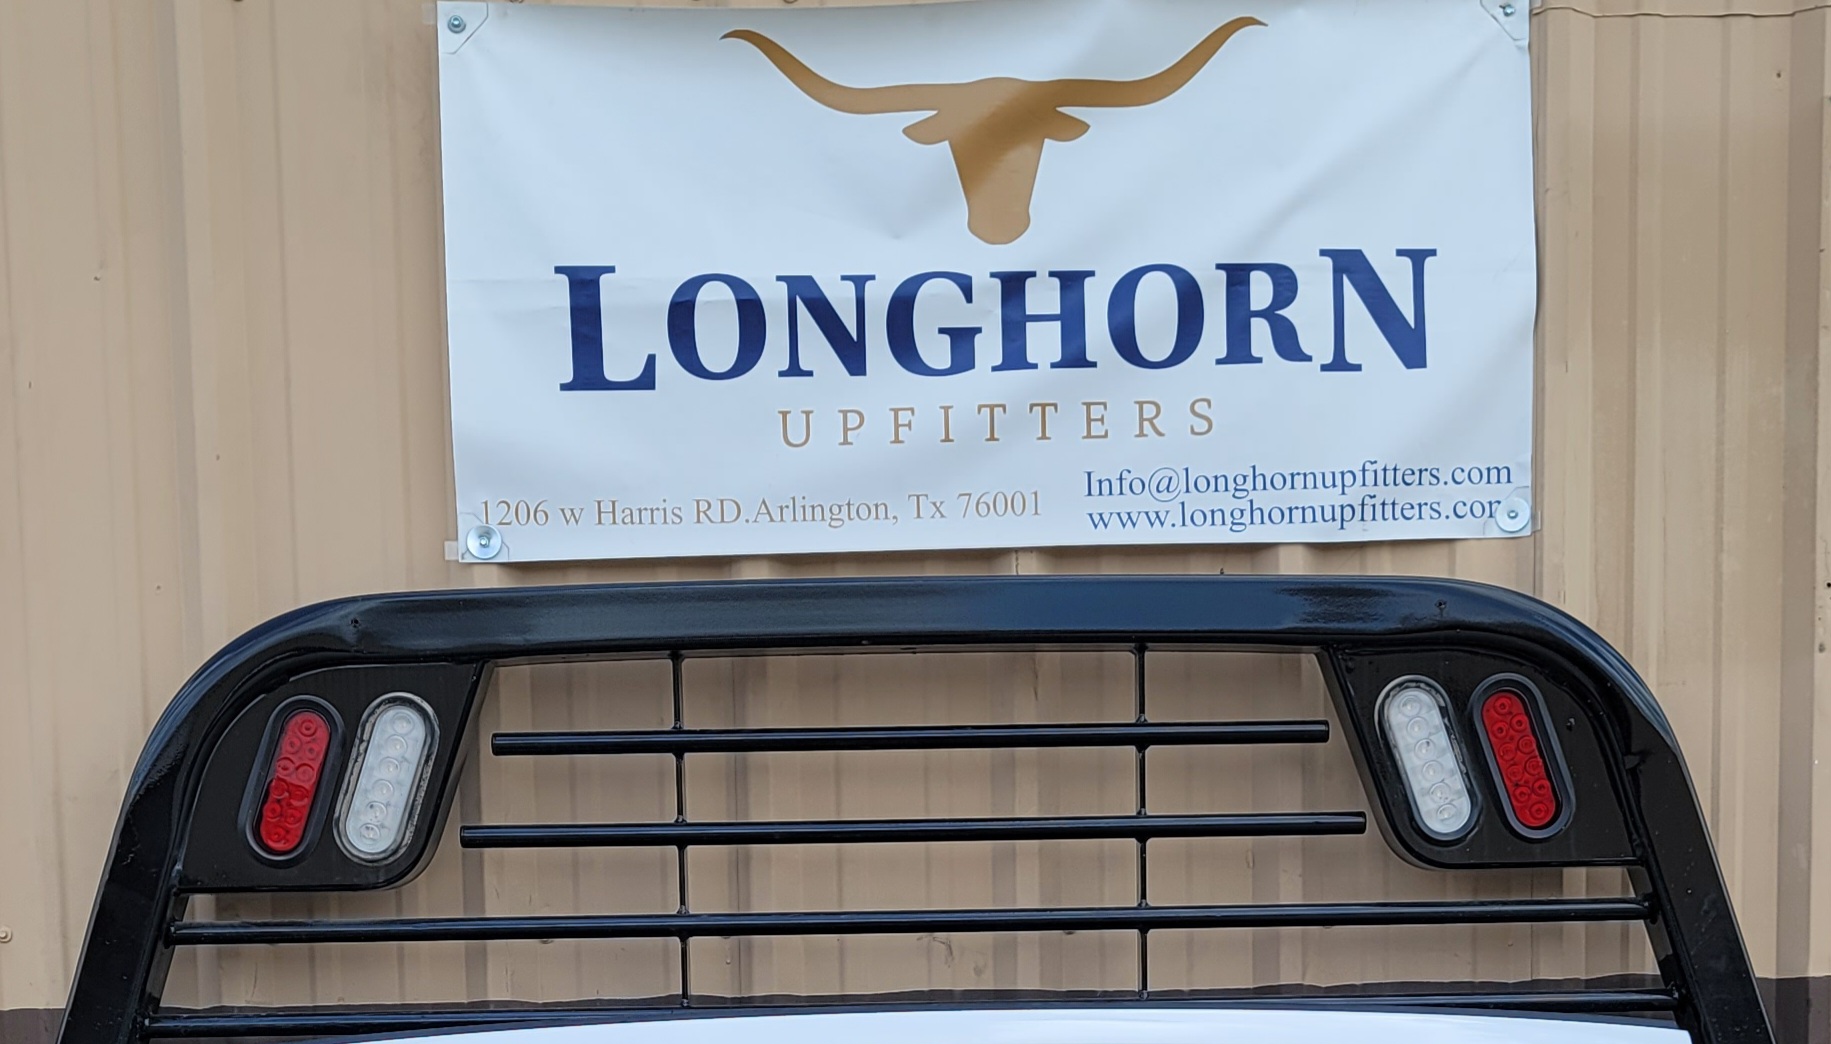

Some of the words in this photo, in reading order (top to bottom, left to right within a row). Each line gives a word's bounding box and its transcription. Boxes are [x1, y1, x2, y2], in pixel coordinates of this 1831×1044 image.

[554, 247, 1438, 392] LONGHORN
[777, 396, 1217, 449] UPFITTERS
[1083, 460, 1514, 502] Info@longhornupfitters.com
[481, 499, 549, 526] 1206
[559, 506, 584, 525] w
[593, 498, 683, 526] Harris
[907, 493, 947, 519] Tx
[956, 489, 1042, 518] 76001
